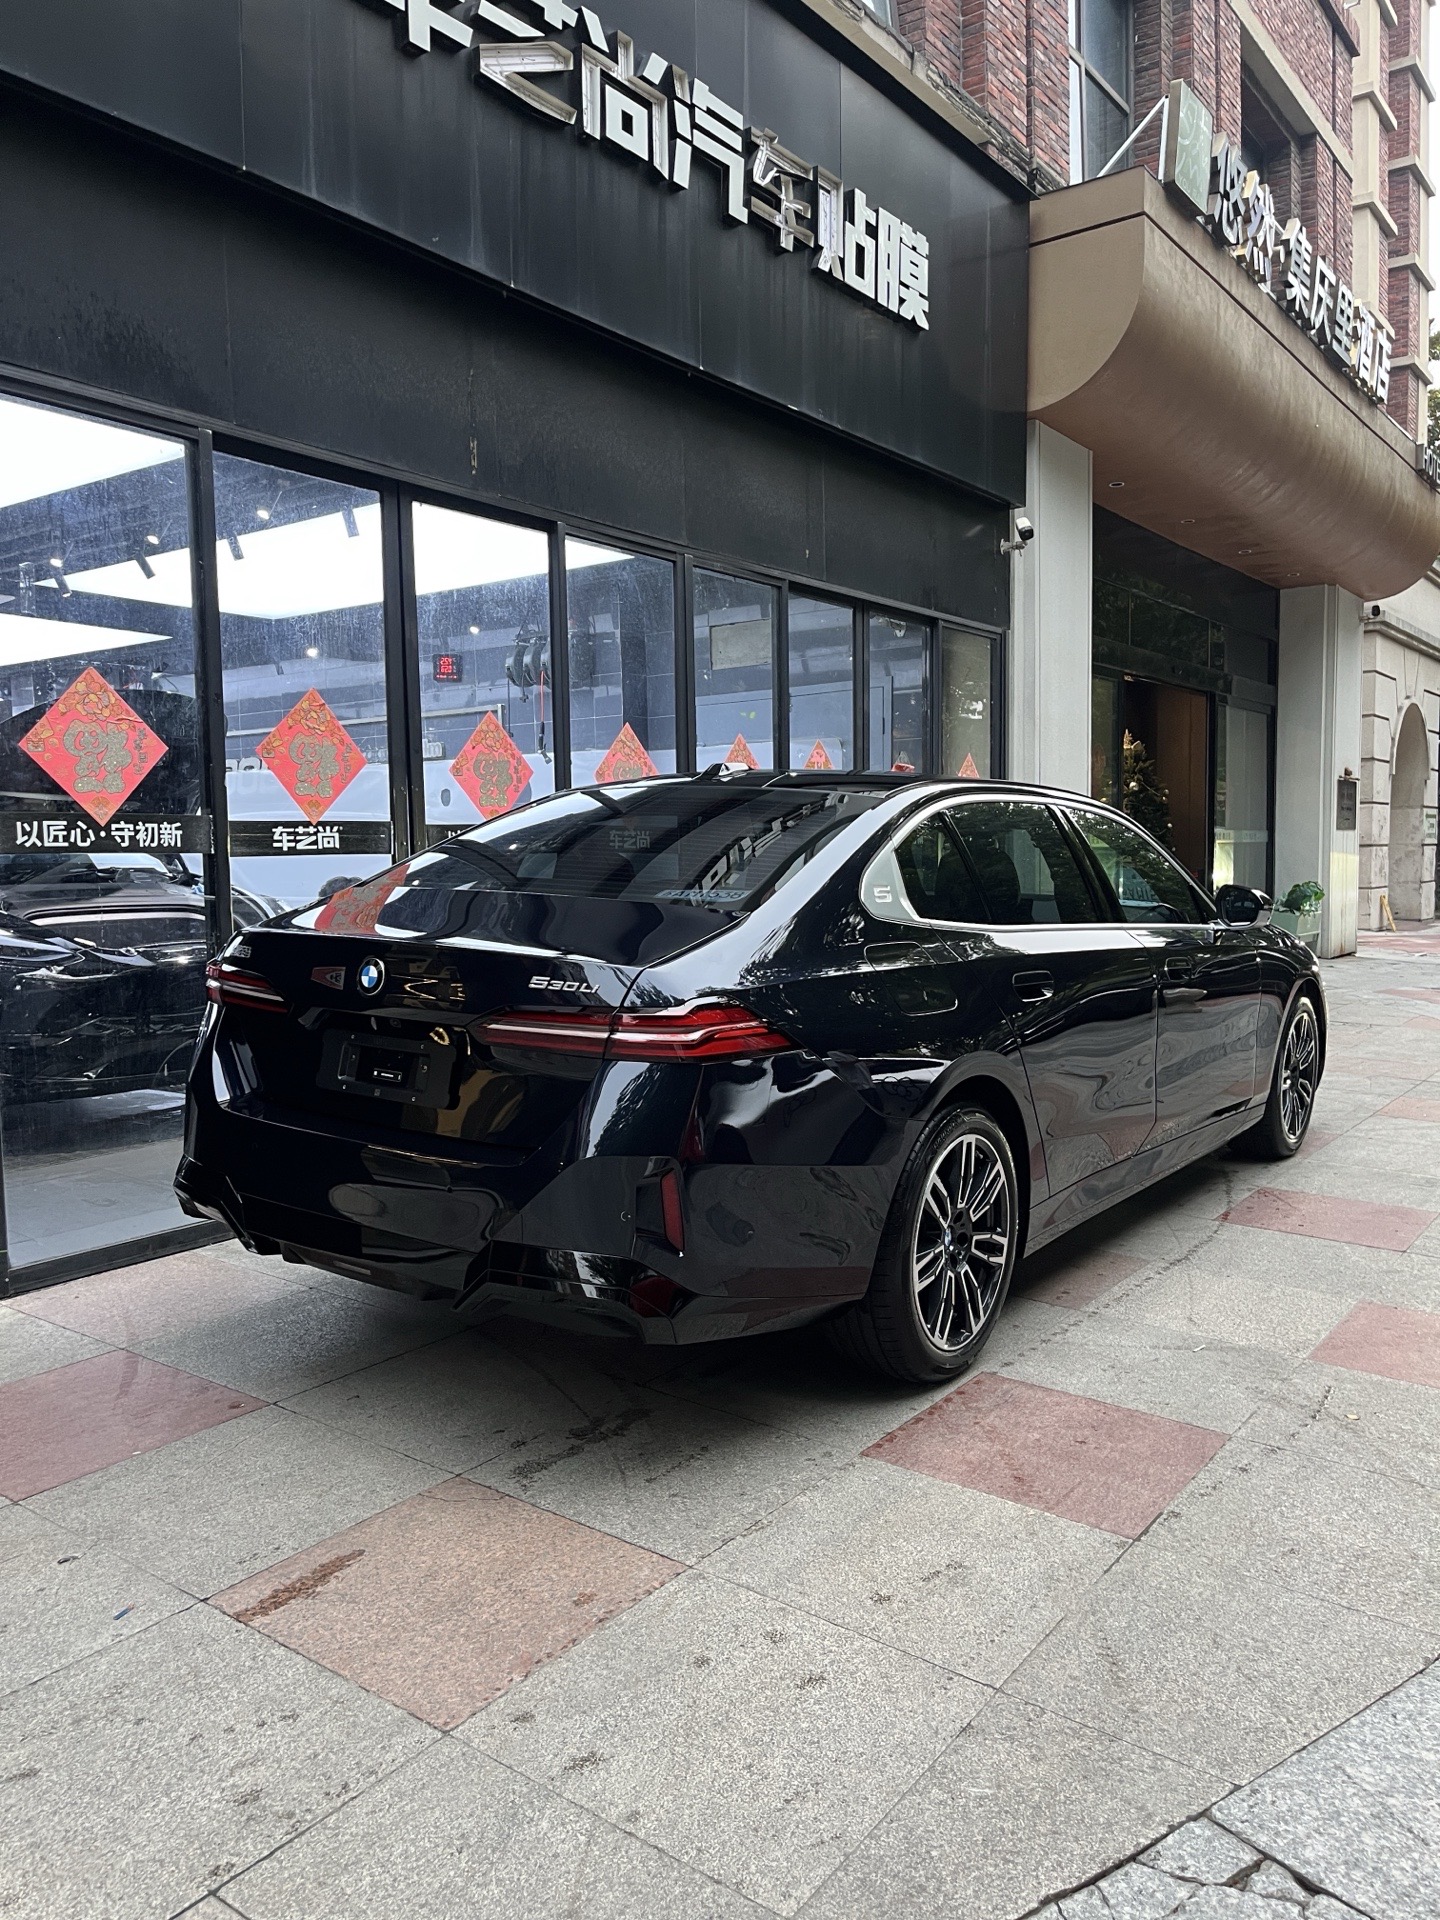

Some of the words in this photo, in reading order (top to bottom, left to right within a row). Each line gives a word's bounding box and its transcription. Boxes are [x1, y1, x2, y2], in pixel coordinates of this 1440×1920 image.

[16, 821, 183, 847] 以匠心·守初新
[271, 825, 340, 851] 车艺尚
[873, 884, 893, 903] 5
